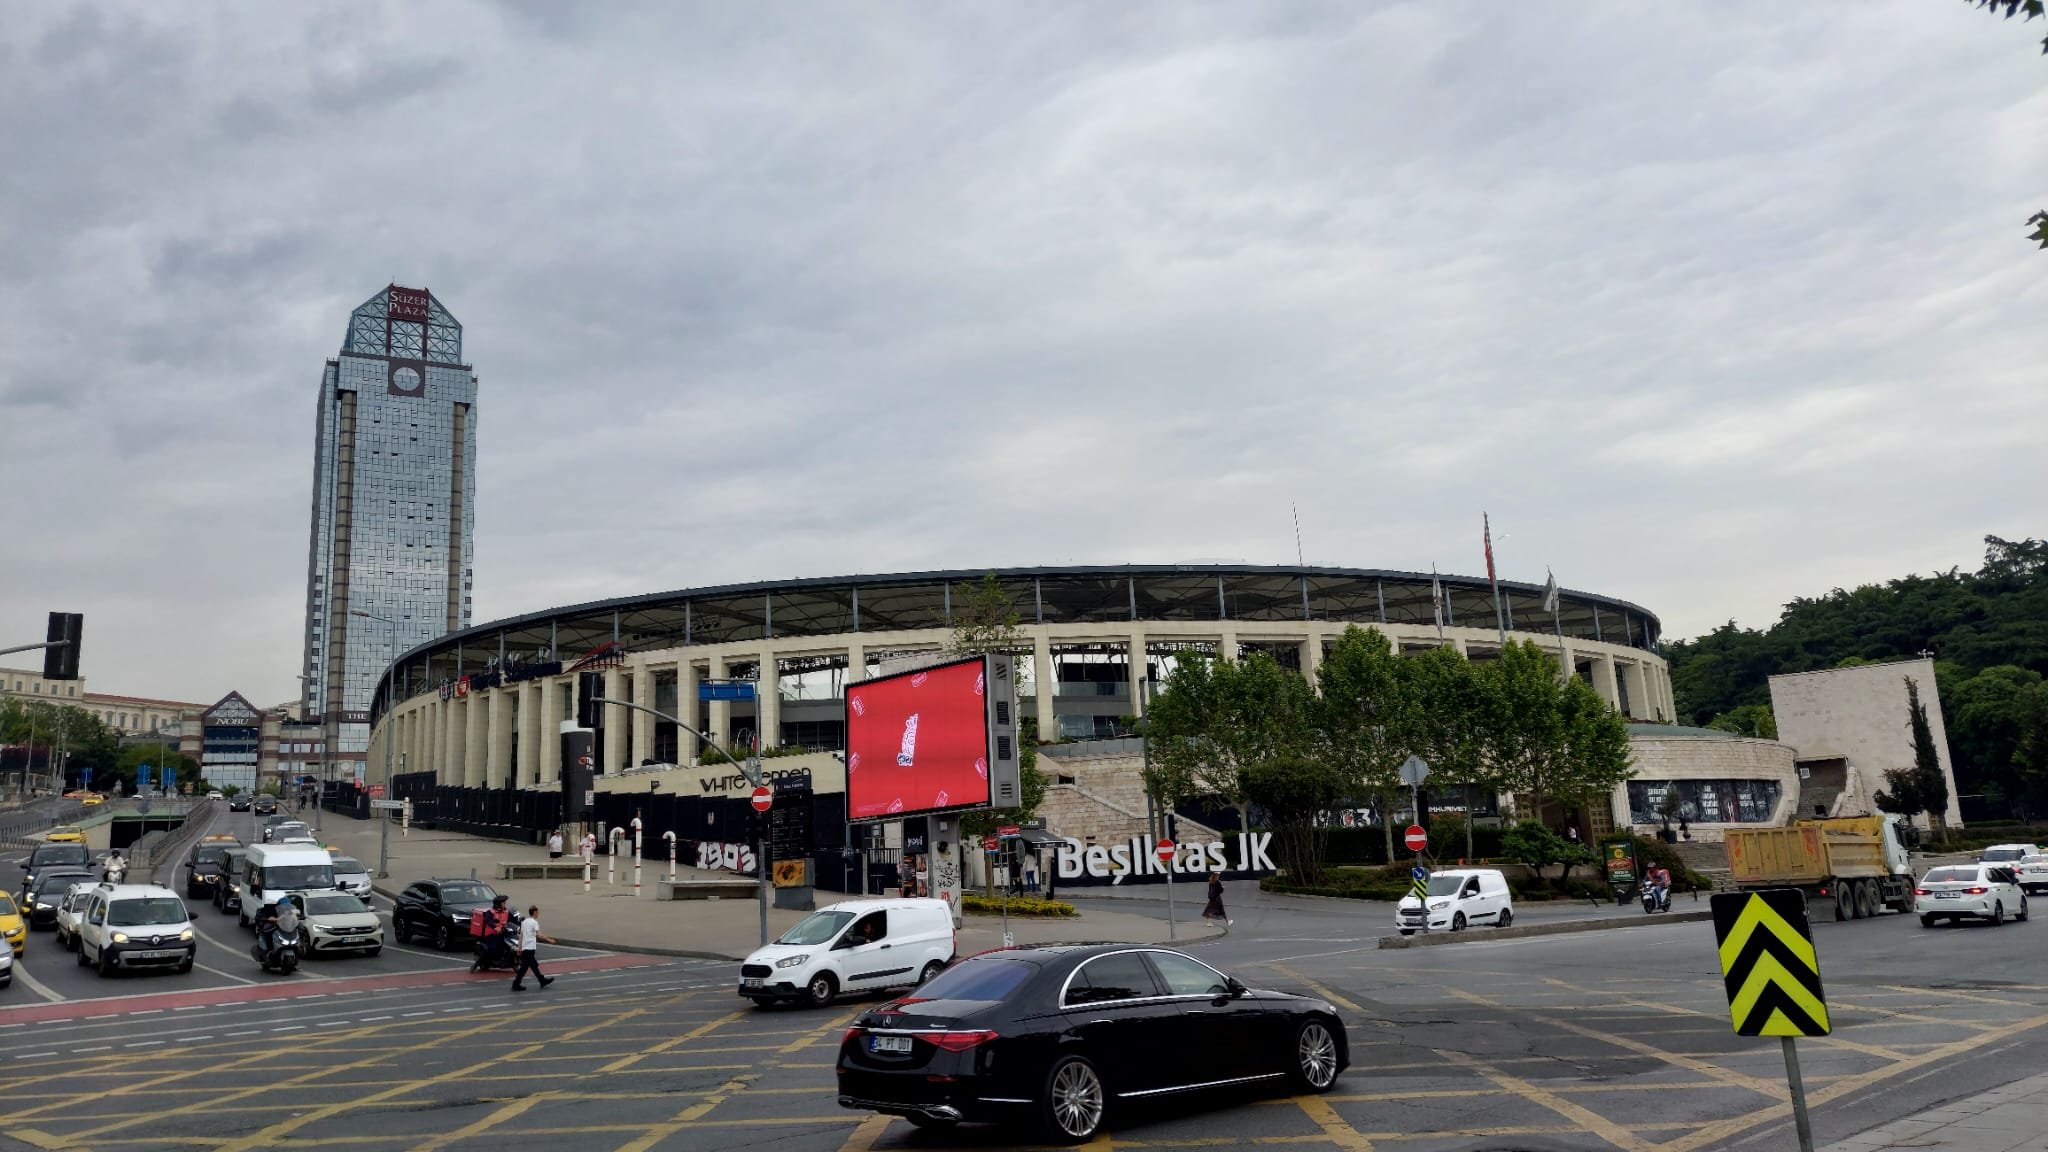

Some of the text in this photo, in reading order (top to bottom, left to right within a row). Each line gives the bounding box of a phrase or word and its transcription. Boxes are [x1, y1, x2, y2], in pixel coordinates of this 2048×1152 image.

[389, 303, 427, 316] PLAZA
[215, 717, 249, 725] NOBU
[346, 712, 368, 720] THE
[696, 841, 756, 873] 1903
[1237, 832, 1277, 871] JK
